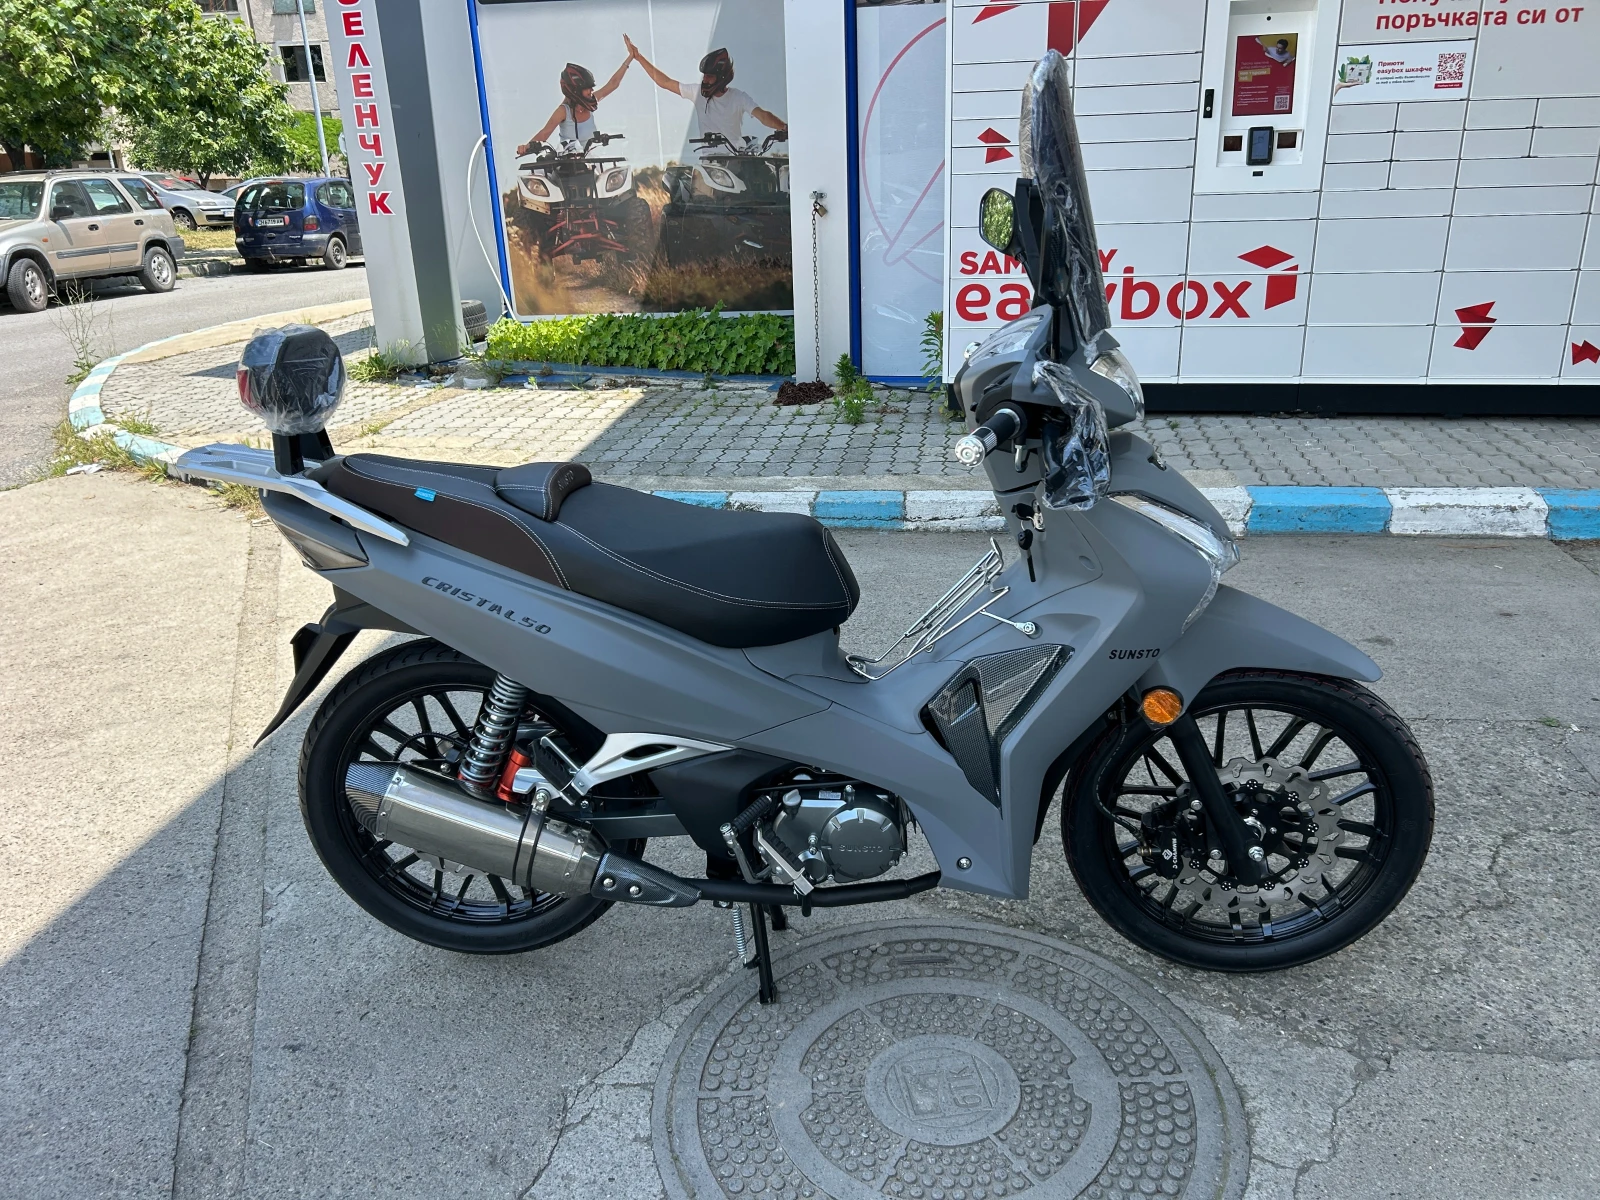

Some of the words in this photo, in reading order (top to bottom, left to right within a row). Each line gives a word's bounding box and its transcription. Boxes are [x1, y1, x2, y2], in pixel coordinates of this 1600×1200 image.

[1376, 10, 1507, 32] поръчката
[1517, 9, 1546, 24] си
[1555, 7, 1584, 23] от
[338, 0, 394, 215] ЕЛЕНЧУК
[960, 248, 1118, 275] SAMY
[955, 266, 1252, 322] eabox
[1109, 648, 1160, 660] SUNSTO
[839, 844, 884, 853] SUNSTO
